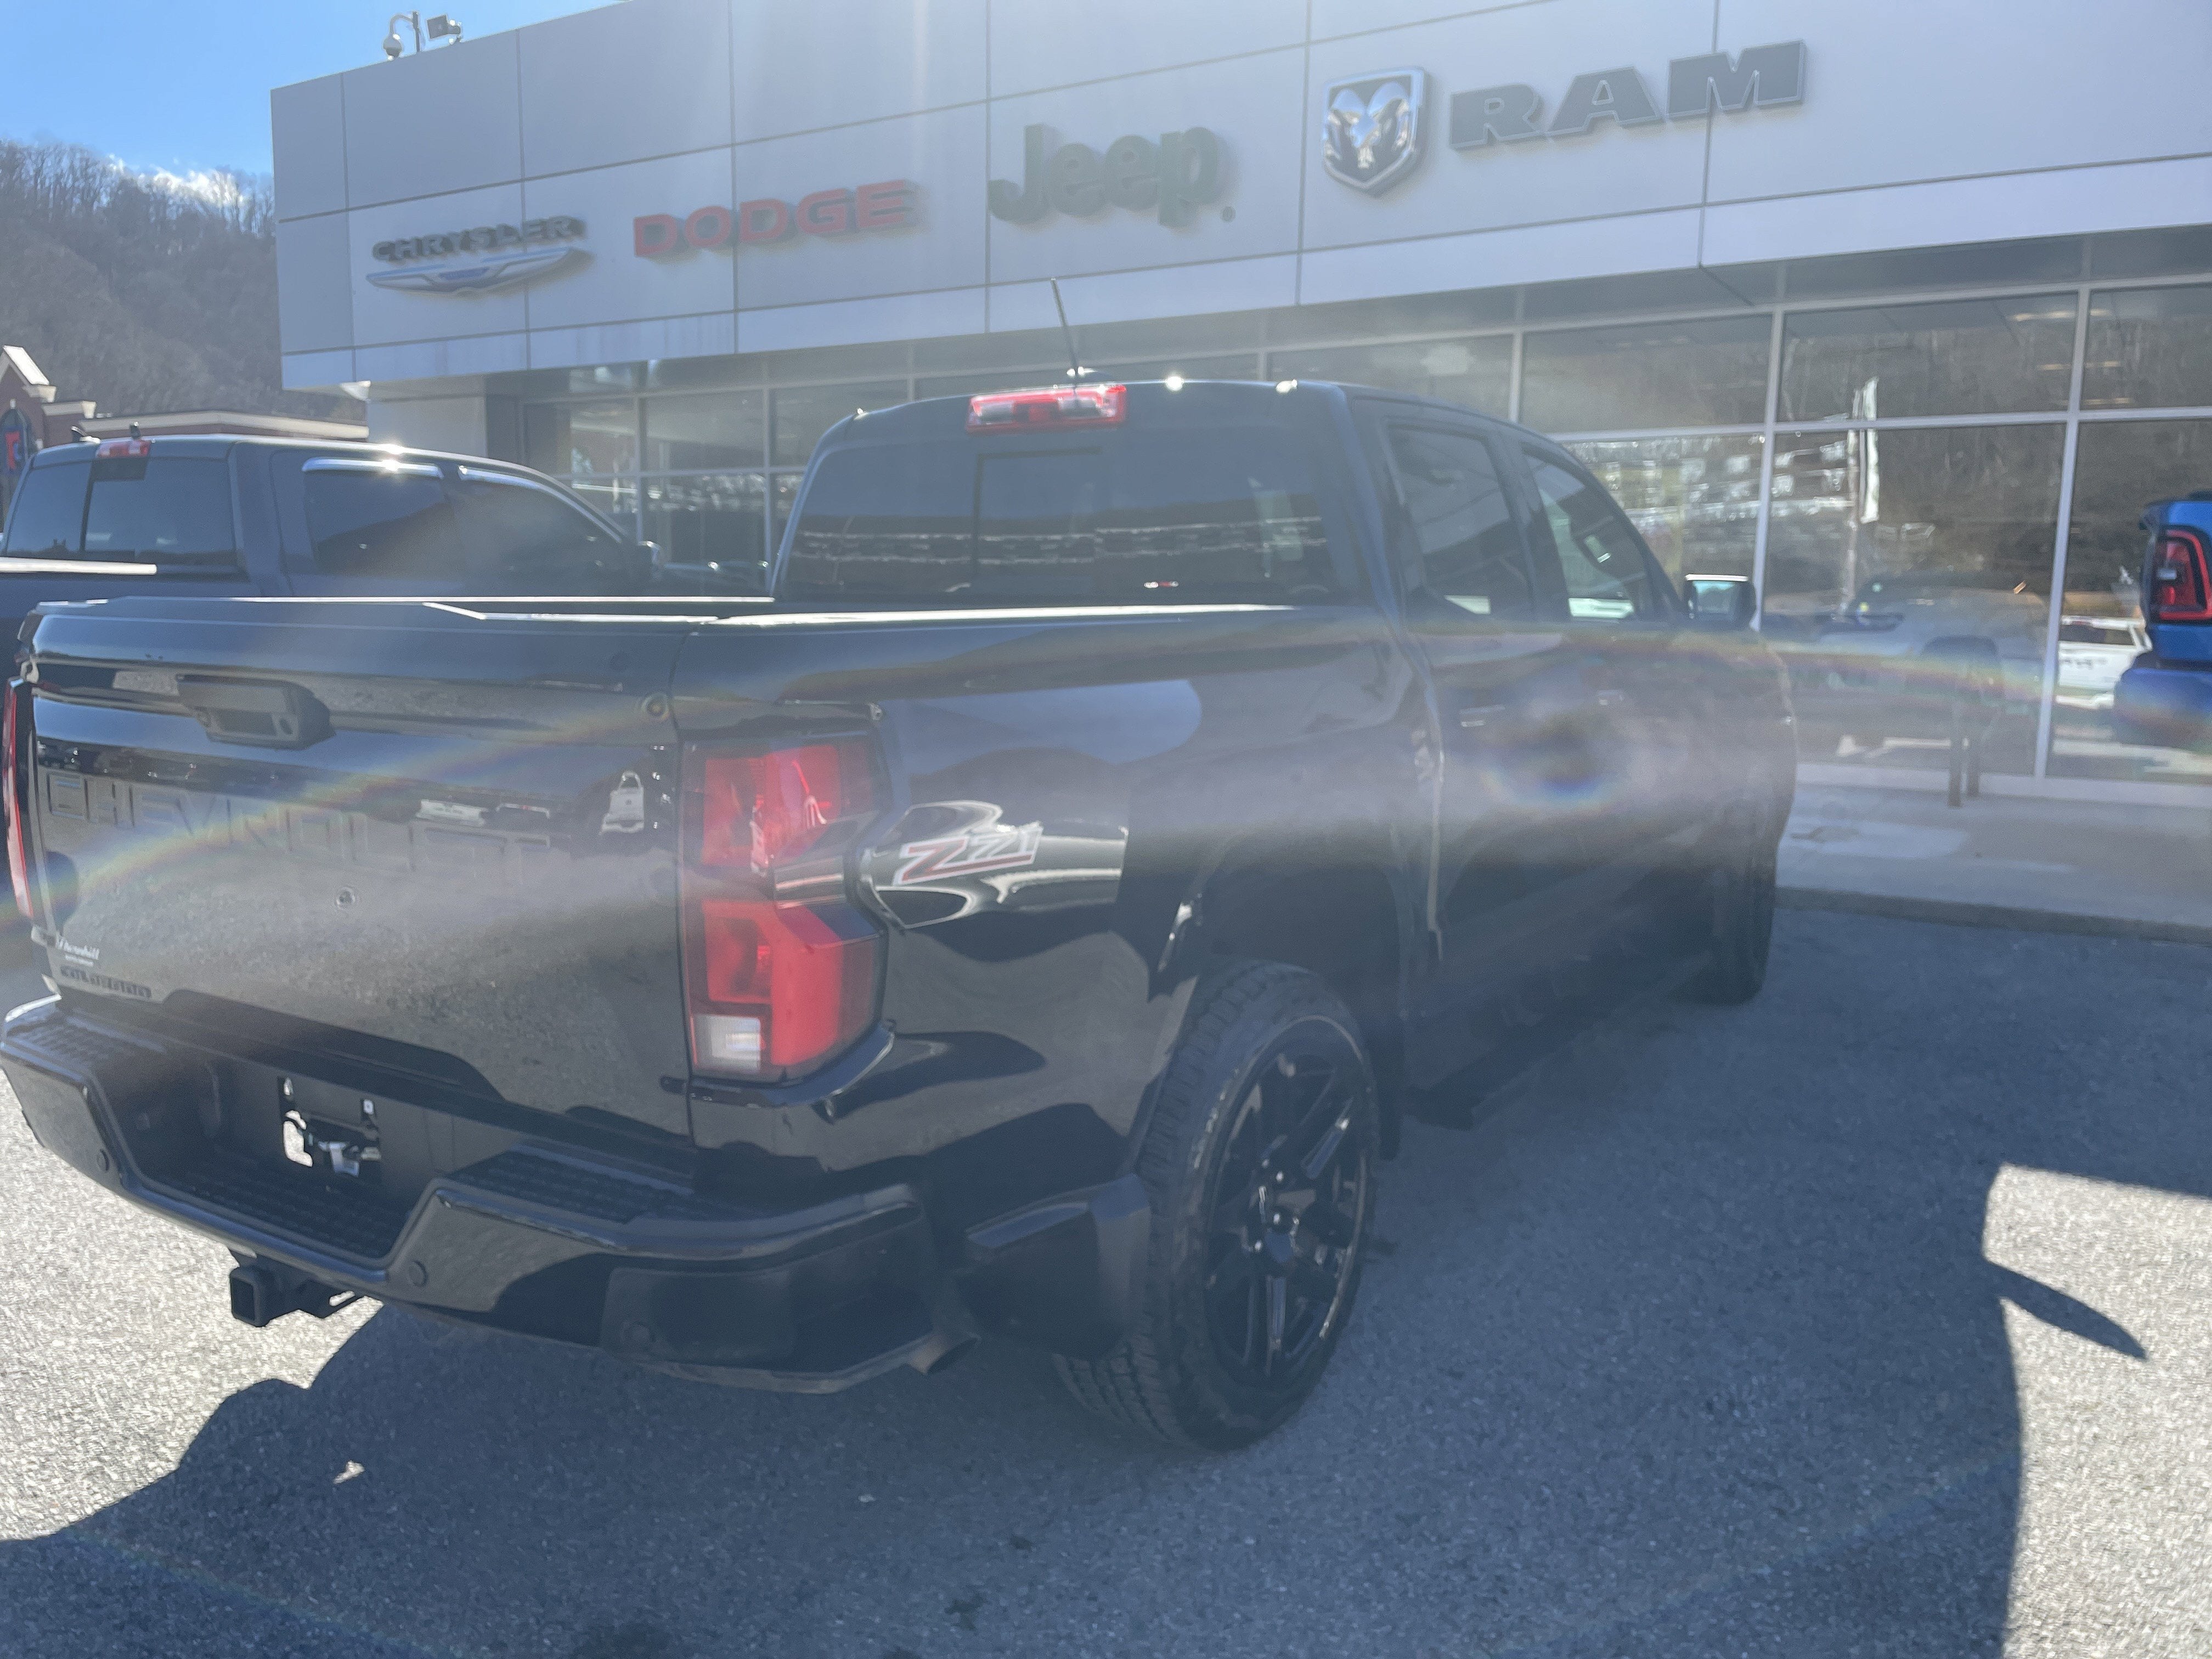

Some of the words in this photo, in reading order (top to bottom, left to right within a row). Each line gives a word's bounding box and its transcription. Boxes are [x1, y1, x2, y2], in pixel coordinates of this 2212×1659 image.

[1449, 39, 1806, 151] RAM
[372, 216, 588, 261] CHRYSLER
[634, 178, 917, 258] DODGE
[893, 821, 1043, 886] Z71
